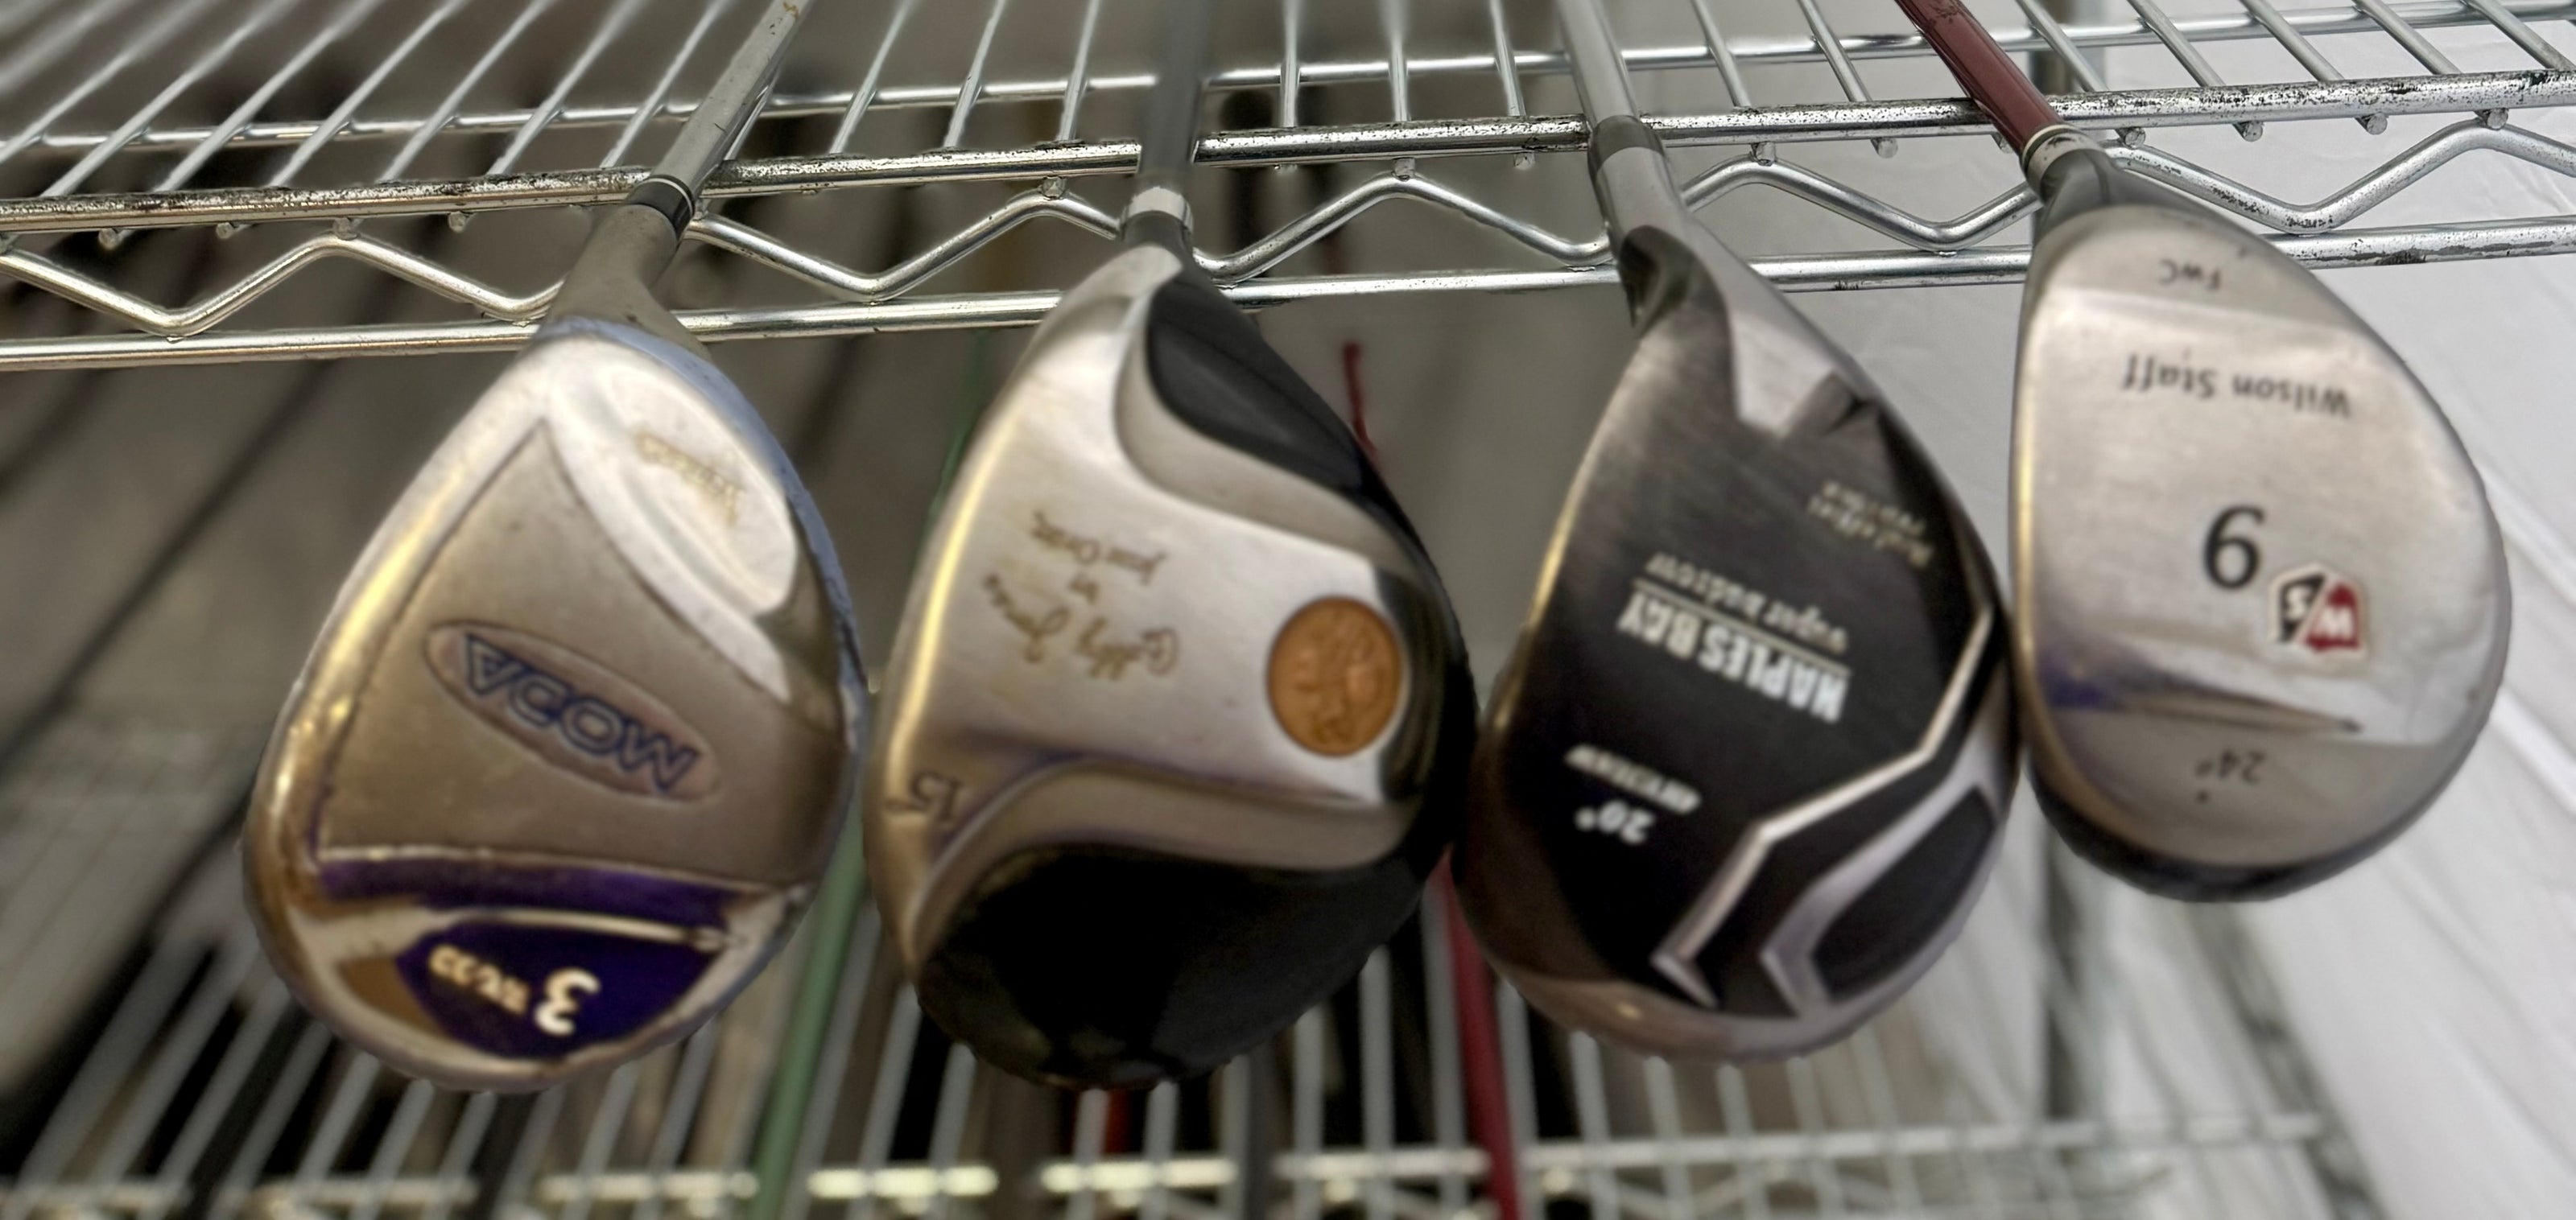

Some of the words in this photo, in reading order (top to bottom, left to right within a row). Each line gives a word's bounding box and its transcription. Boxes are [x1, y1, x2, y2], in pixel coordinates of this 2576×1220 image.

[2120, 353, 2219, 399] Staff
[2231, 375, 2352, 420] Wilson
[2202, 505, 2266, 592] 9
[1615, 591, 1699, 658] BAY
[1699, 620, 1851, 724] NAPLES
[461, 632, 700, 795] MODA
[532, 966, 601, 1037] 3
